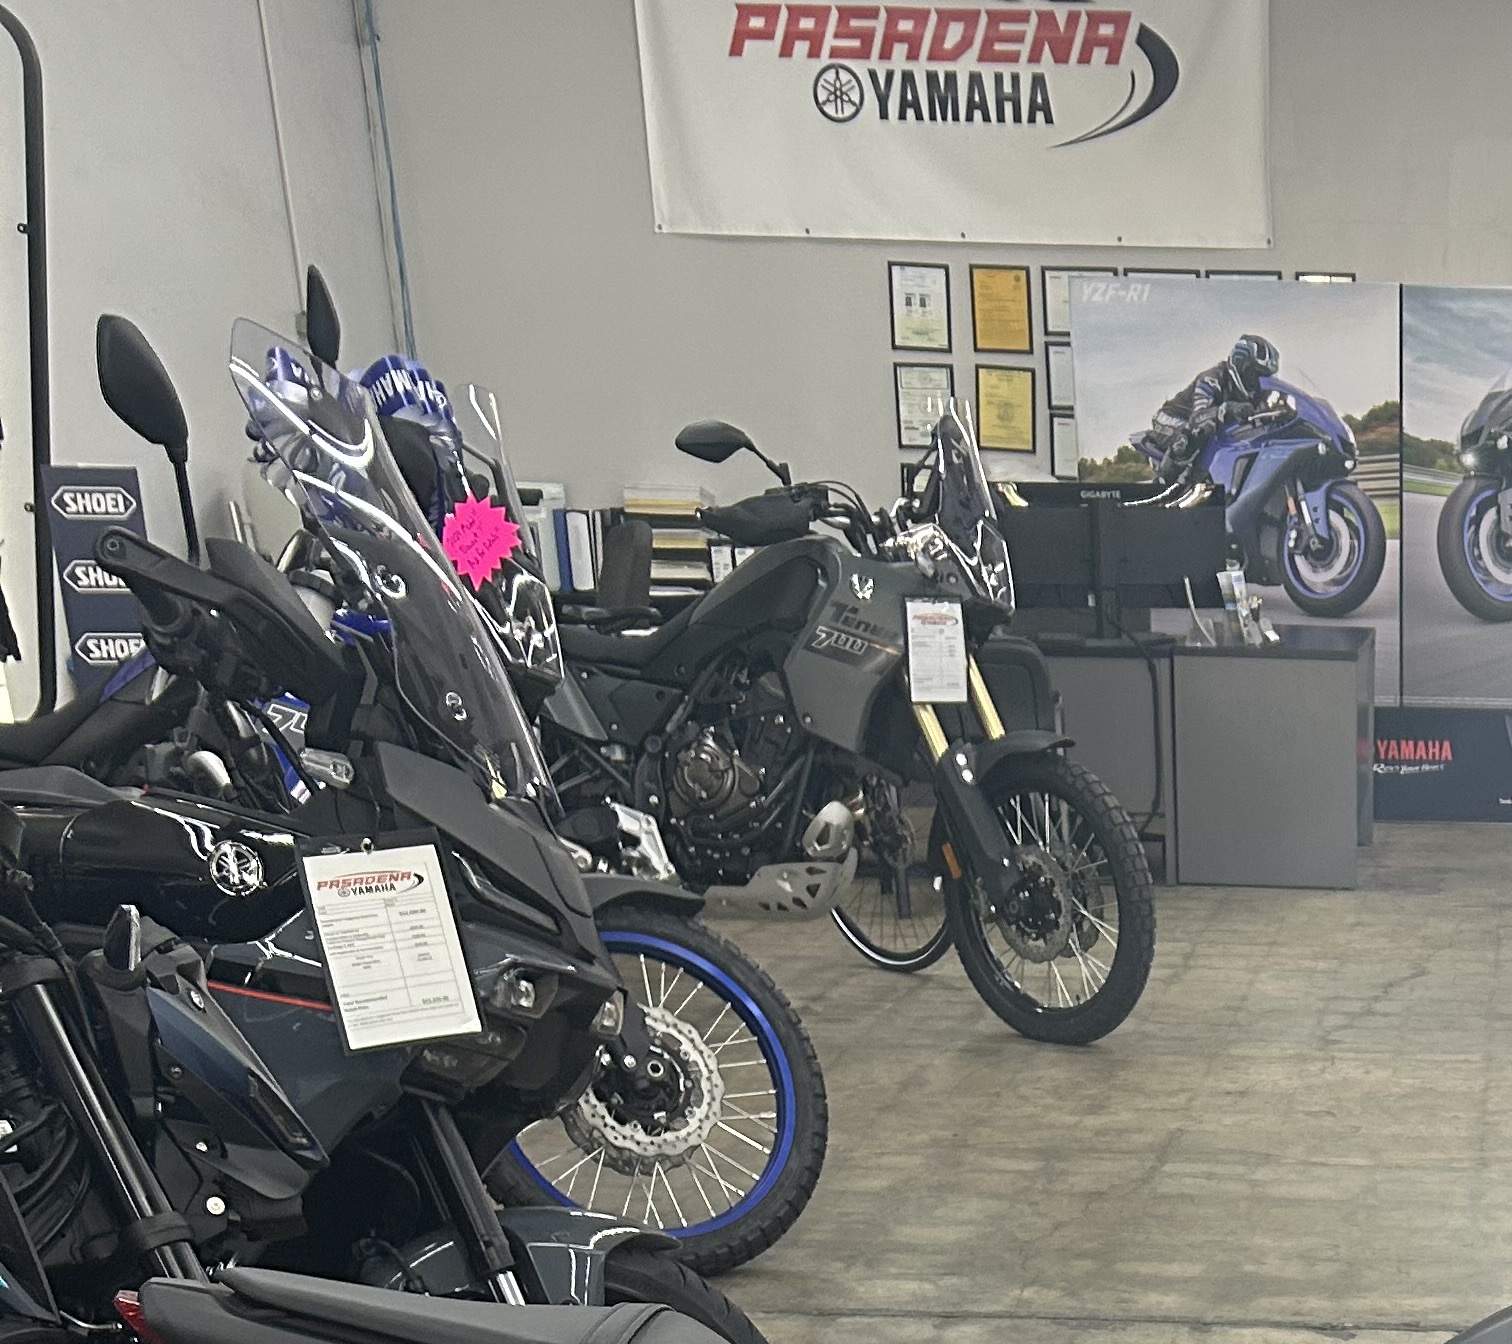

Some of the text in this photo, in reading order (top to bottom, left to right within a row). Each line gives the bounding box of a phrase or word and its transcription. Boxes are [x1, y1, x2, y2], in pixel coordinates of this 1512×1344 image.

[728, 3, 1132, 65] PASADENA
[868, 69, 1055, 125] YAMAHA
[1082, 282, 1152, 303] YZF-R1
[62, 492, 125, 513] SHOEI
[811, 625, 868, 656] 700
[1377, 739, 1453, 761] YAMAHA
[316, 871, 412, 892] PASADENA
[351, 882, 397, 897] YAMAHA
